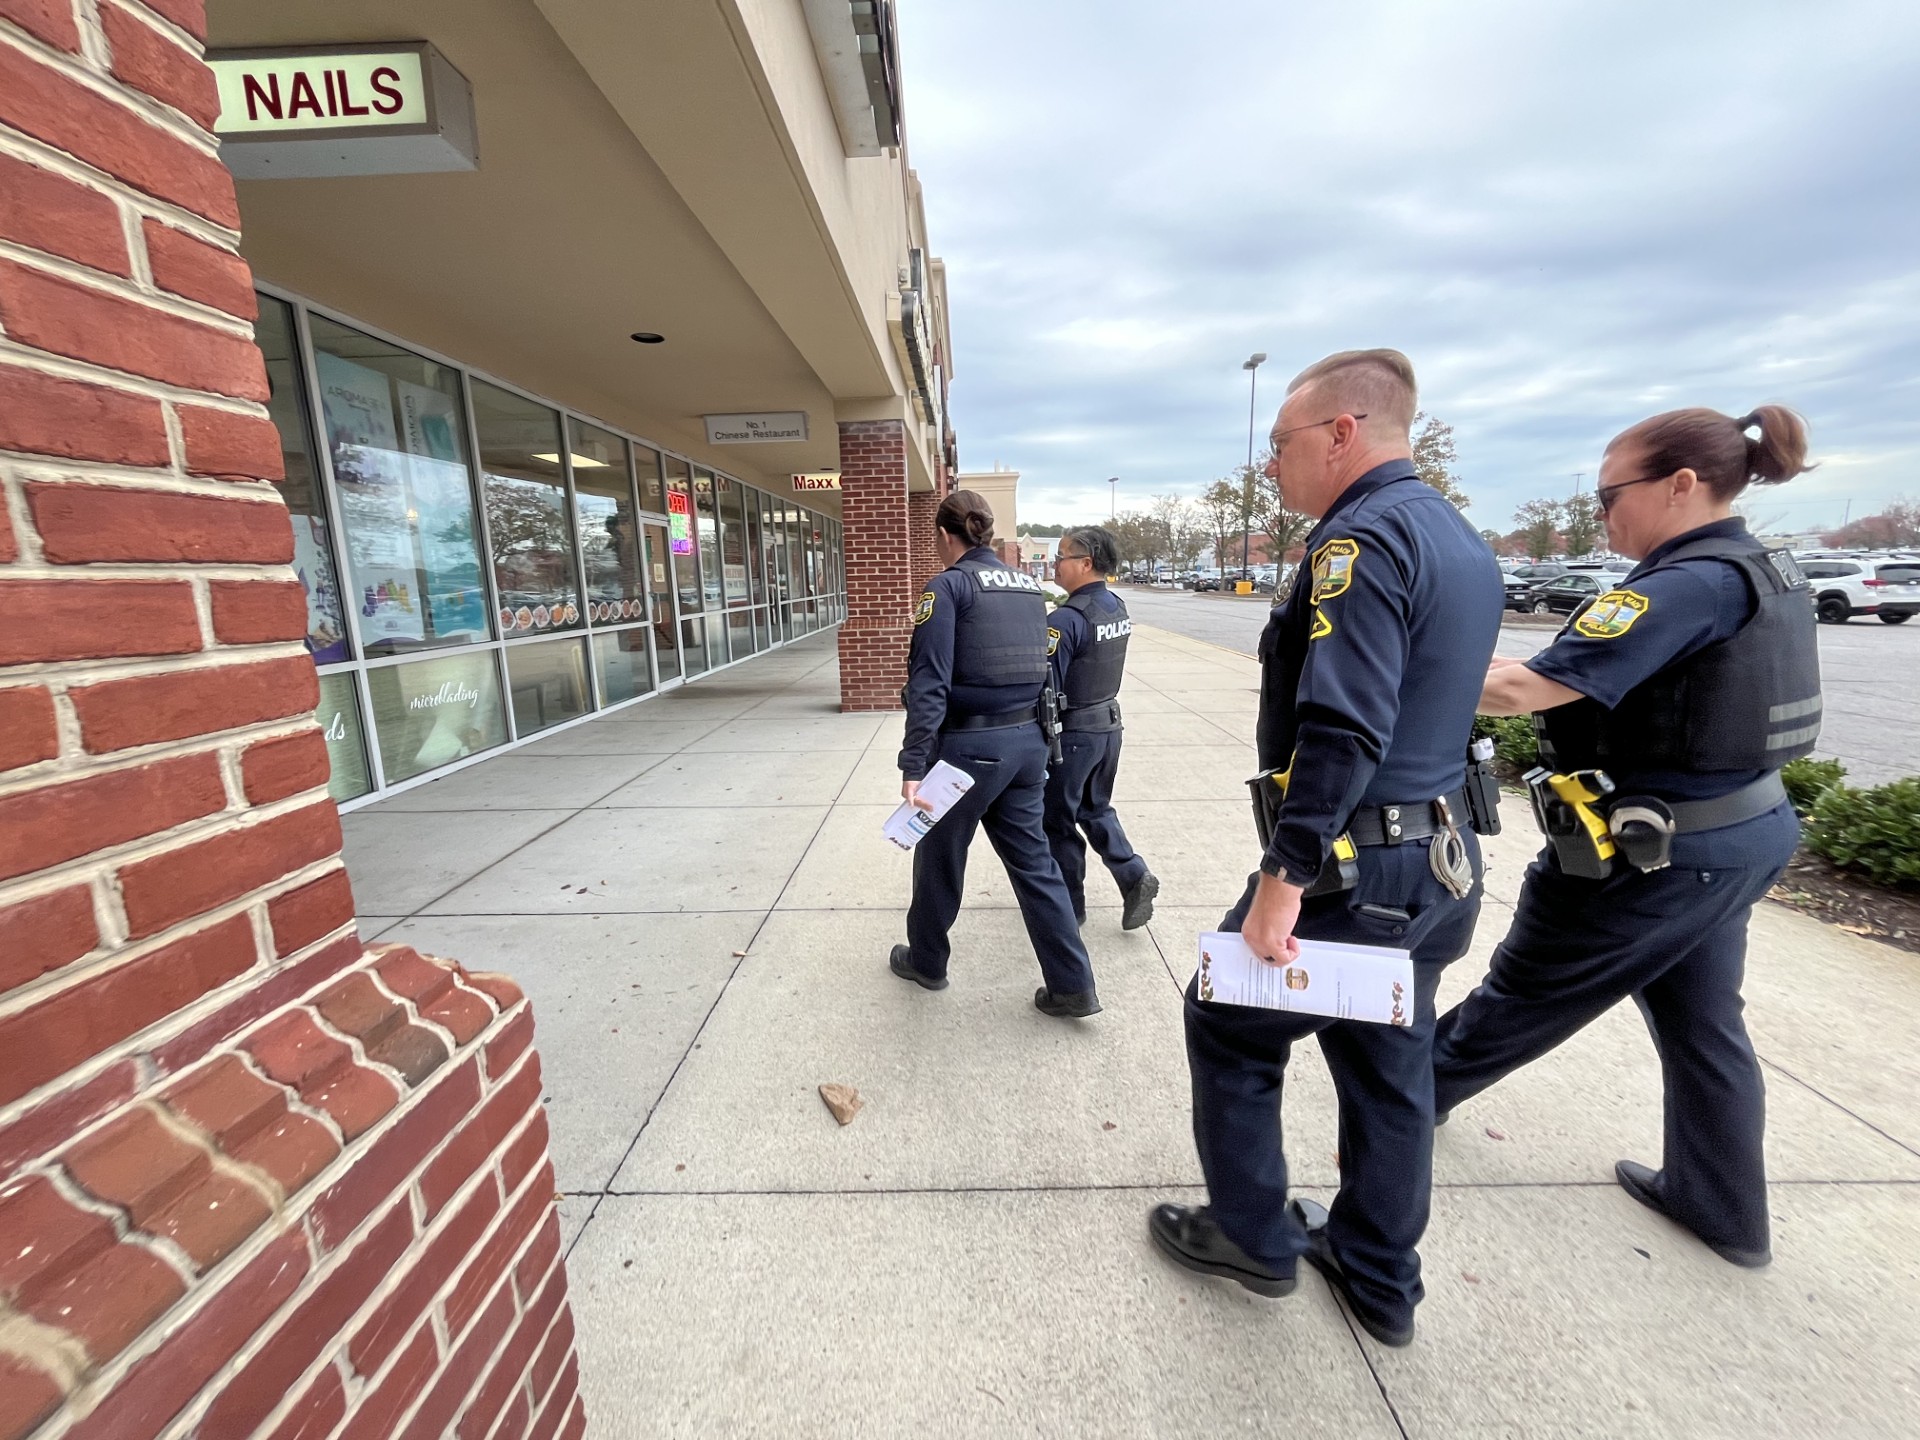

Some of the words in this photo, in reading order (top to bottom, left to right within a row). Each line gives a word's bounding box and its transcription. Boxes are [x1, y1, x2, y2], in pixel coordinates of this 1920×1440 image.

[242, 66, 404, 121] NAILS
[714, 431, 750, 440] Chinese
[752, 429, 800, 438] Restaurant
[745, 421, 760, 429] No.
[793, 475, 834, 490] Maxx
[978, 570, 1041, 591] POLICE
[1096, 618, 1131, 642] POLICE
[410, 681, 480, 711] microblading
[324, 712, 346, 741] ds
